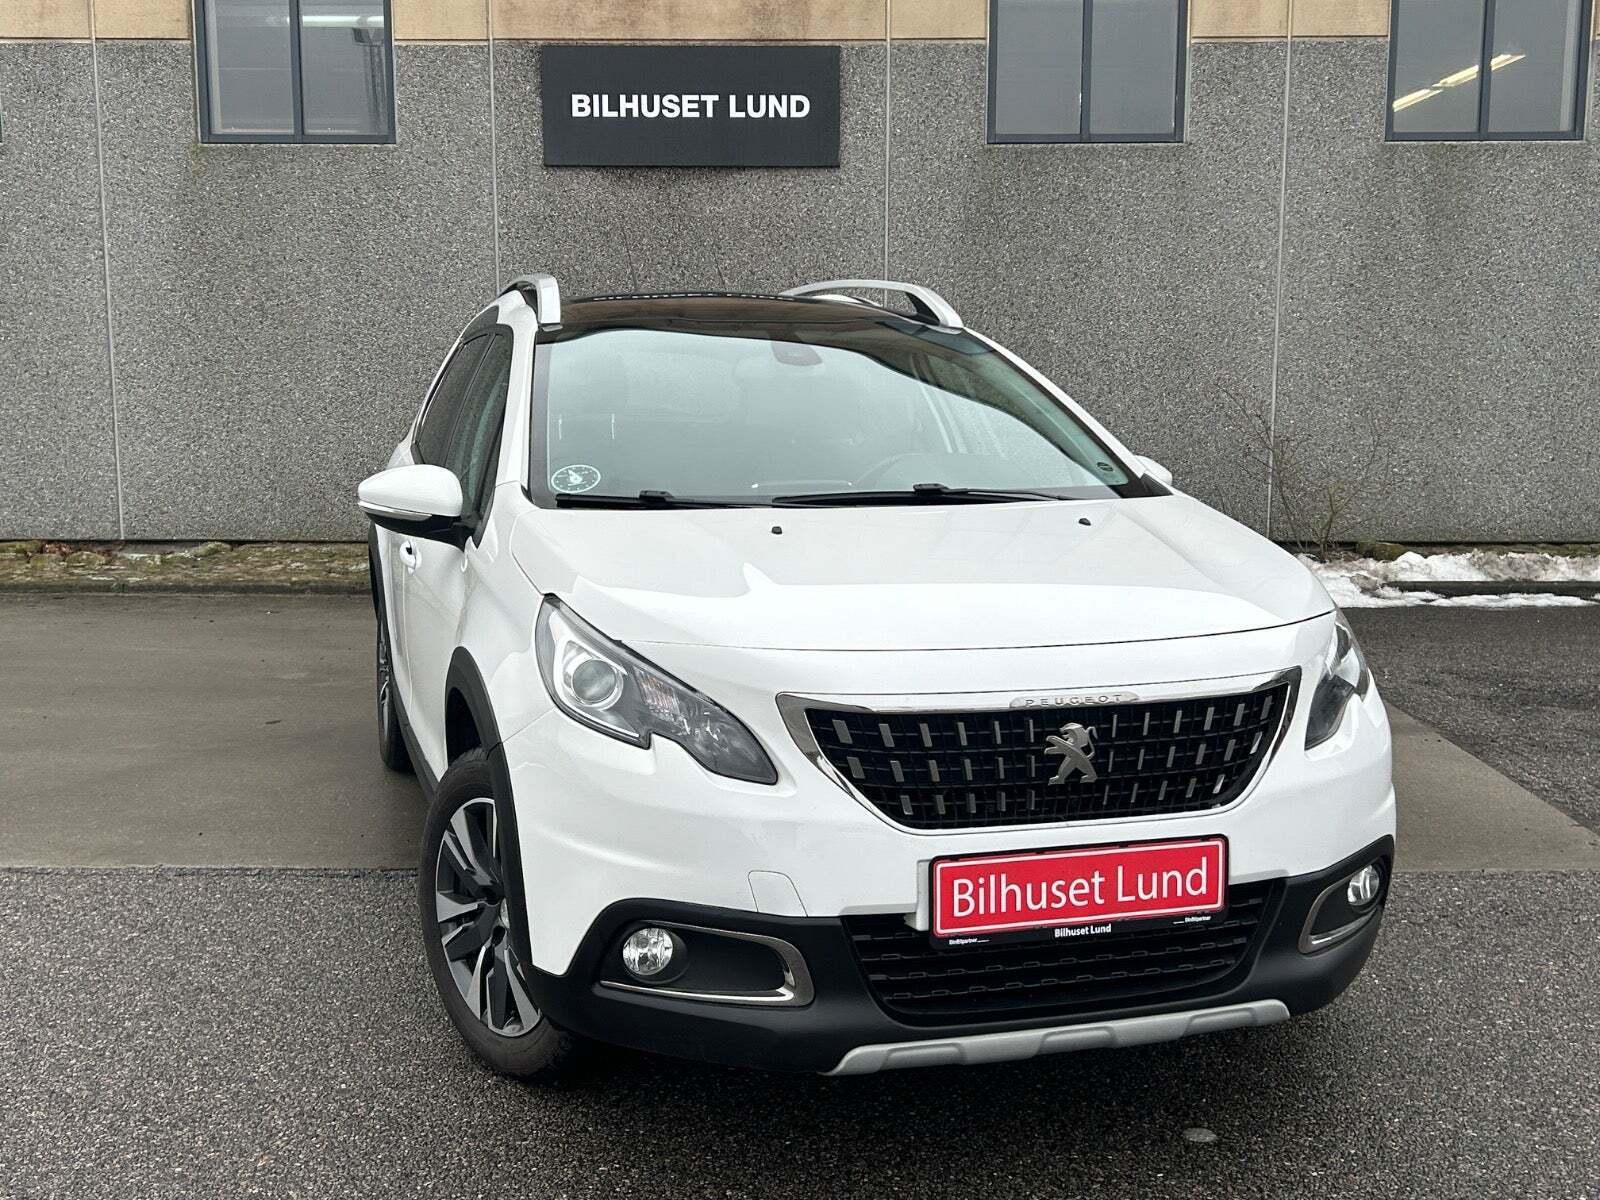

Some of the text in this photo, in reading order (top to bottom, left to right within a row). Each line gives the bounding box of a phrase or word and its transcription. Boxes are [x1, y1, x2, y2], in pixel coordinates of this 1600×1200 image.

[571, 94, 810, 118] BILHUSET LUND
[1025, 694, 1122, 706] PEUGEOT
[953, 857, 1207, 917] Bilhuset Lund
[1054, 923, 1112, 938] Bilhuset Lund
